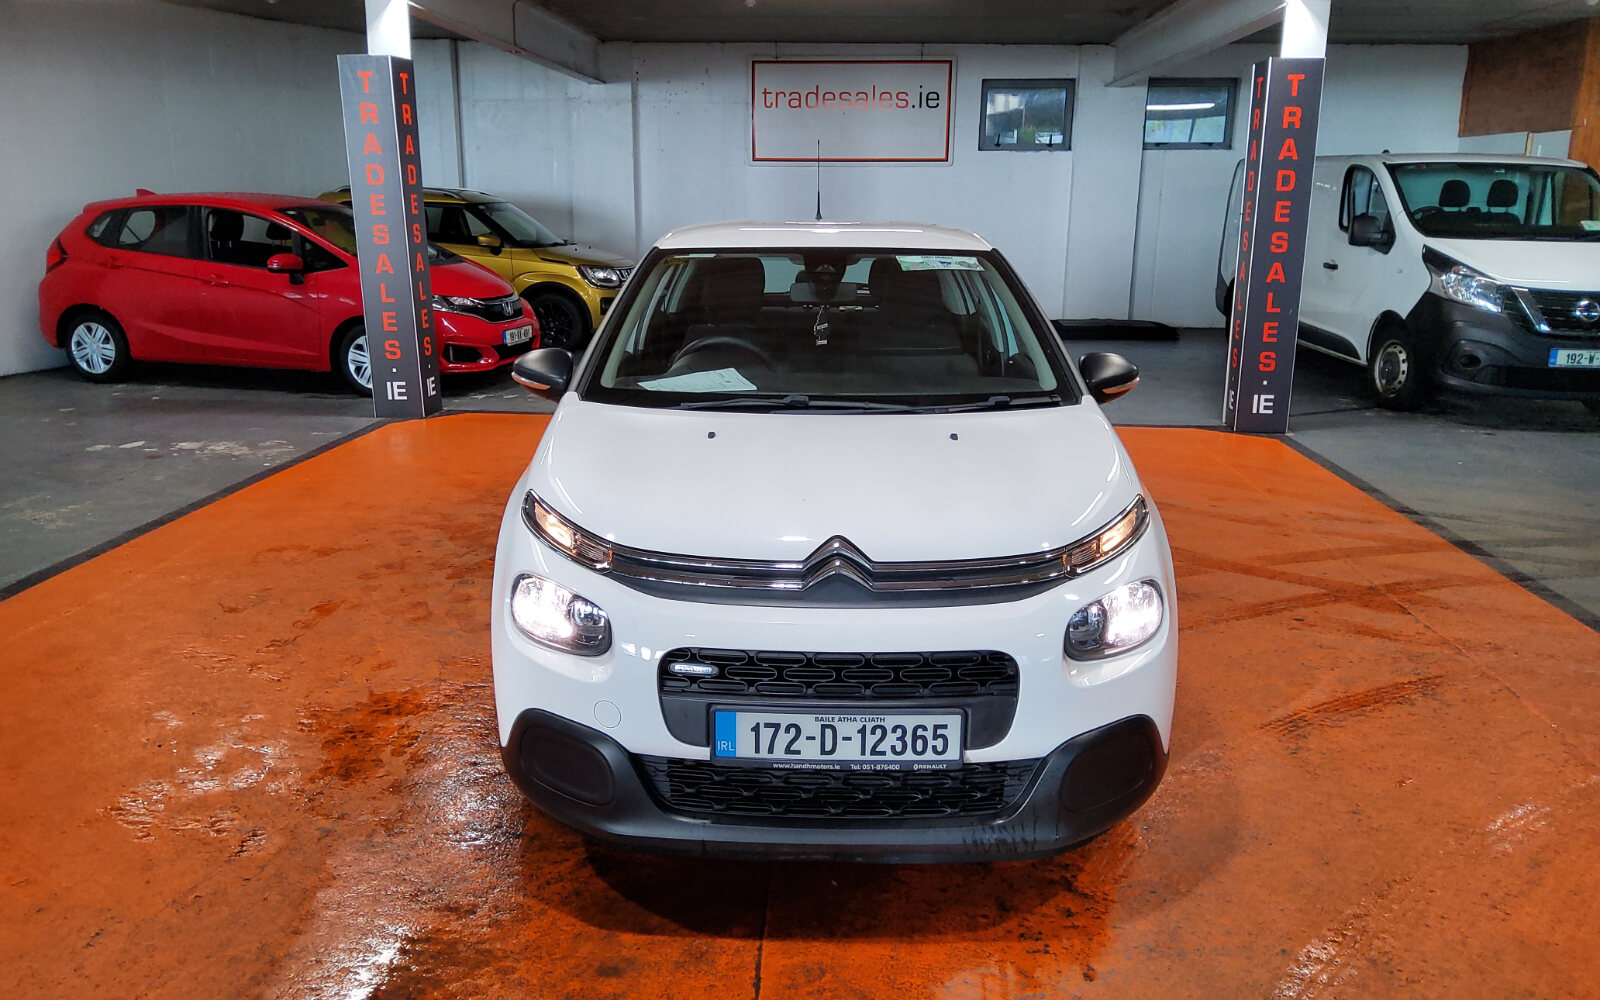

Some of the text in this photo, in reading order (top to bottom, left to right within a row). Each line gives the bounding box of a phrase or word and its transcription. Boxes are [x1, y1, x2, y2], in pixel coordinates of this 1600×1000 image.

[762, 85, 940, 109] tradesales.ie
[717, 740, 735, 751] IRL
[750, 722, 949, 756] 172-D-12365
